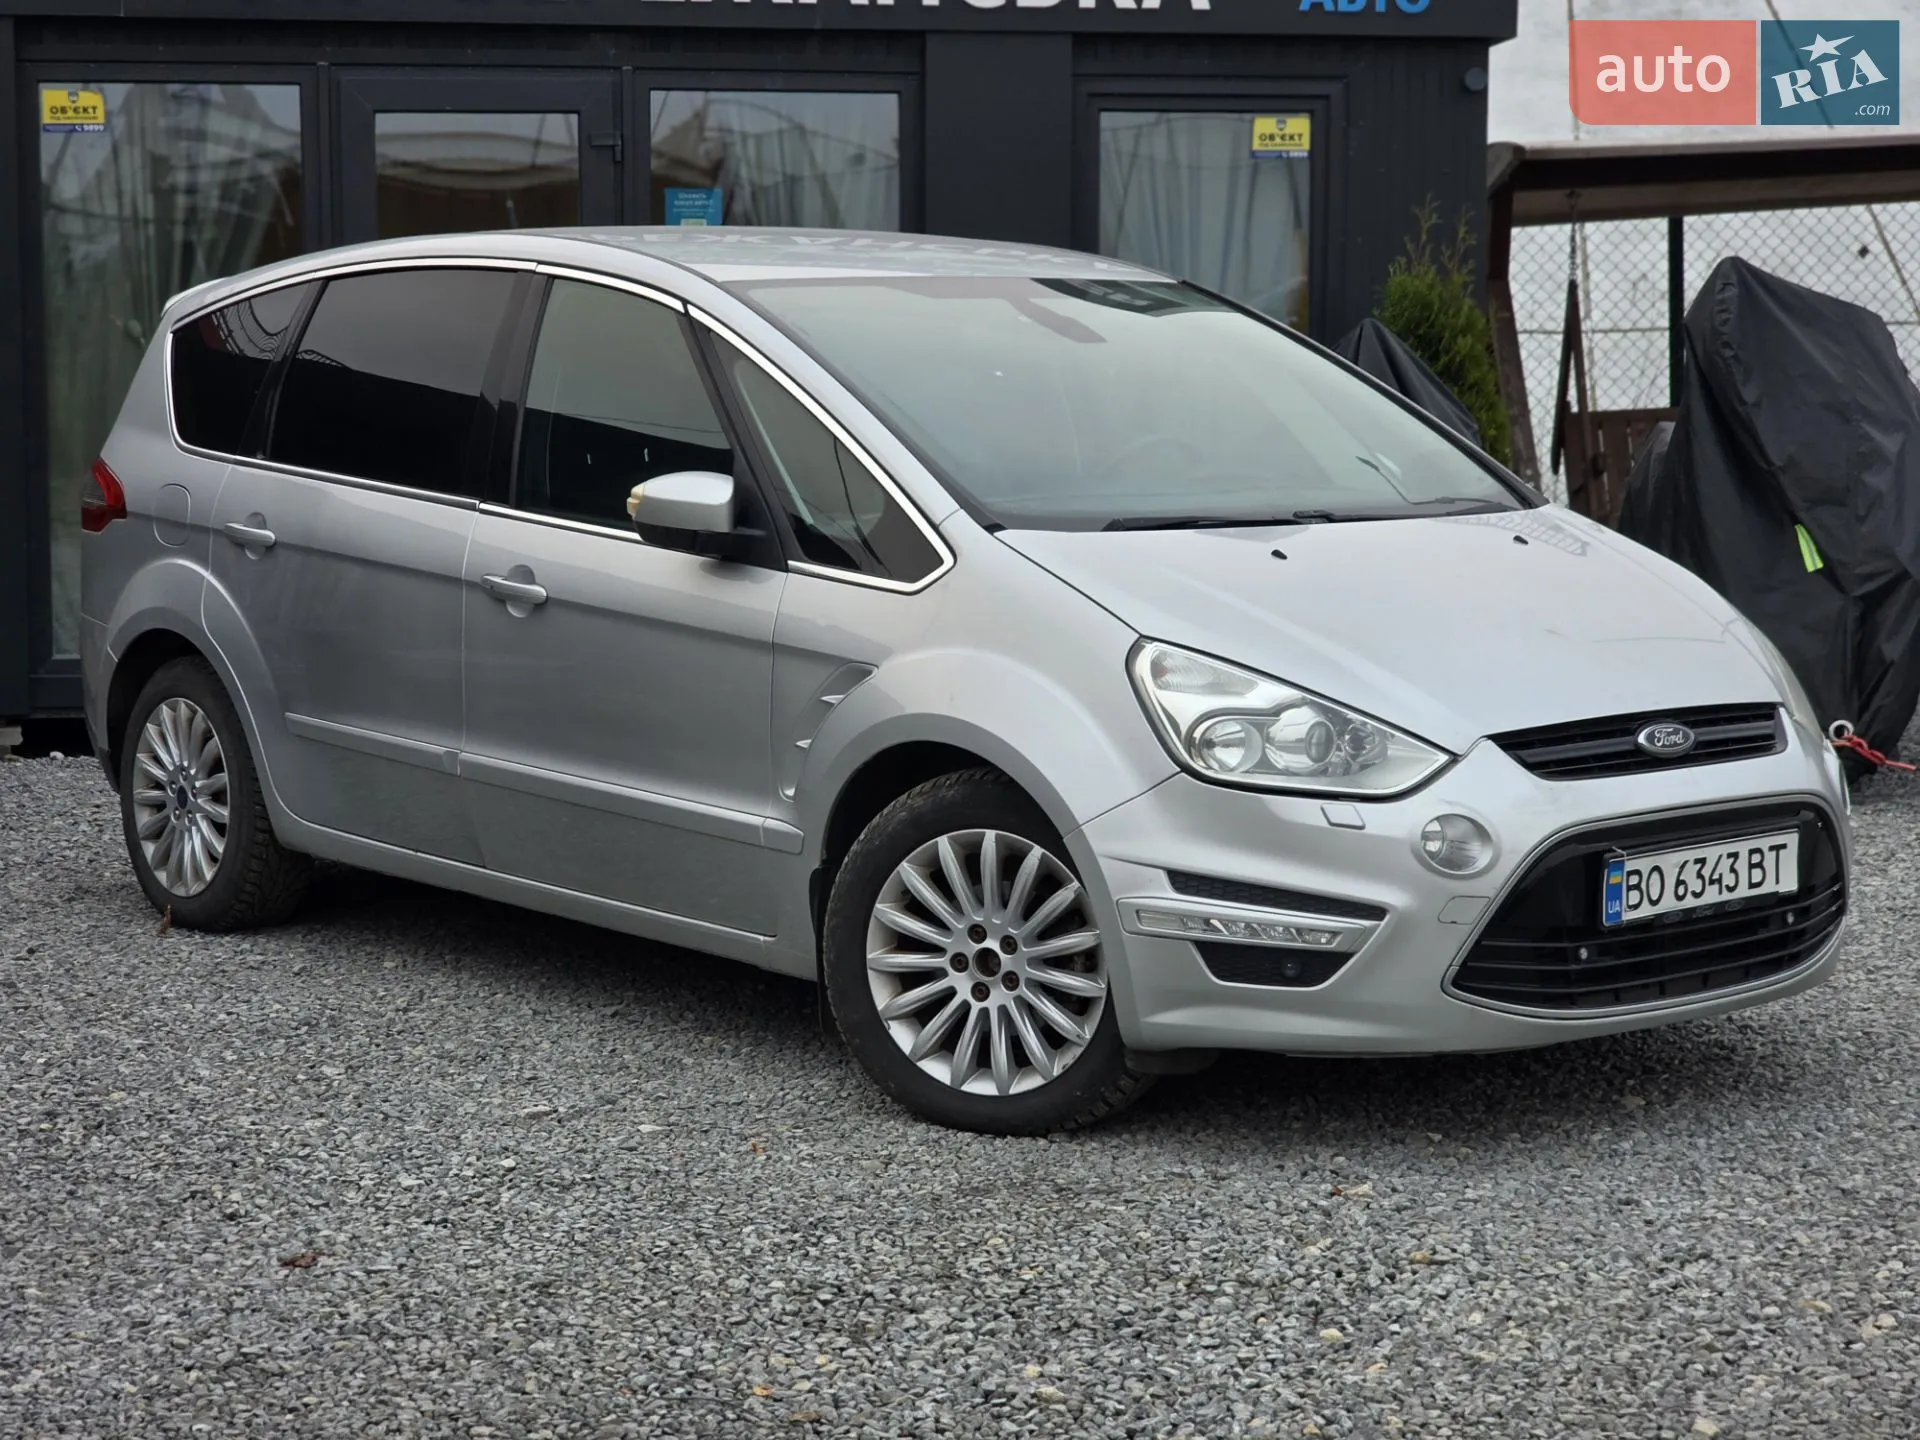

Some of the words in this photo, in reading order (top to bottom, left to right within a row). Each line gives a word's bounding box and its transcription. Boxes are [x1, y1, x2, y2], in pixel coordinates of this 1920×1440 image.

[1654, 727, 1685, 747] Ford
[1625, 864, 1665, 912] BO
[1674, 851, 1740, 902] 6343
[1747, 843, 1788, 891] BT
[1608, 900, 1621, 914] UA
